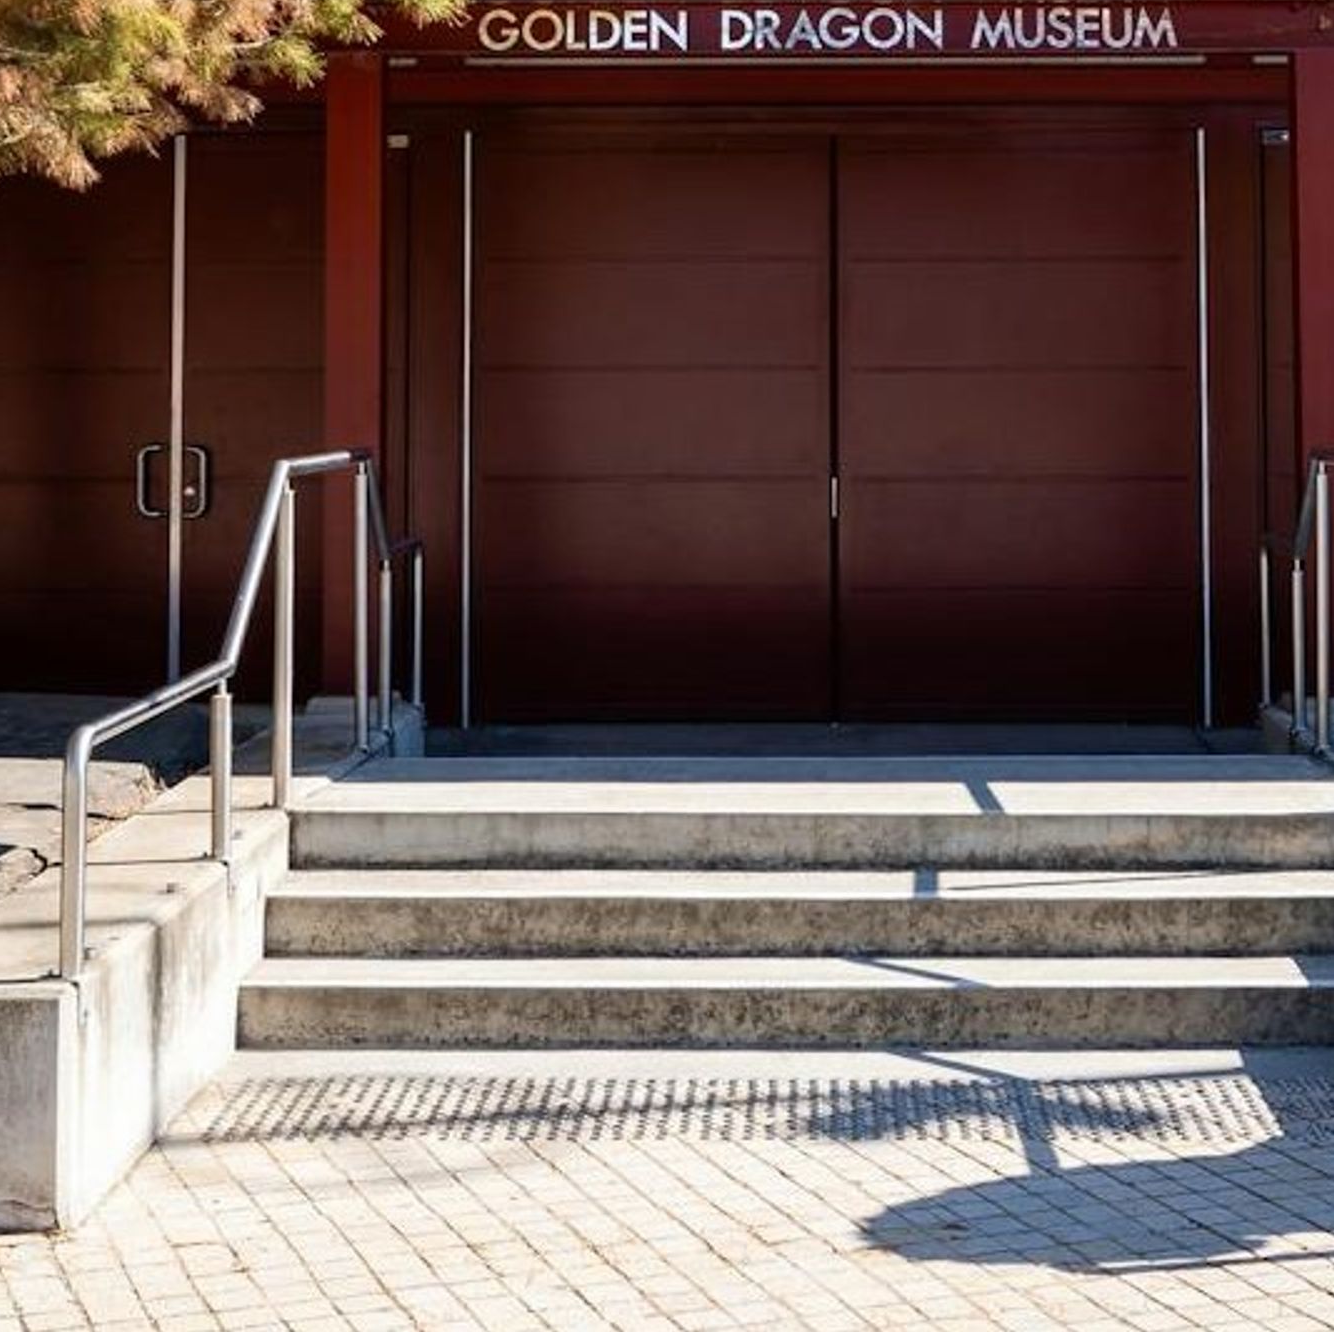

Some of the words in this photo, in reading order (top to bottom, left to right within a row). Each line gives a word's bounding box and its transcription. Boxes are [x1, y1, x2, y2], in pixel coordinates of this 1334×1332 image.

[478, 7, 688, 52] GOLDEN
[720, 7, 944, 52] DRAGON
[970, 7, 1179, 51] MUSEUM
